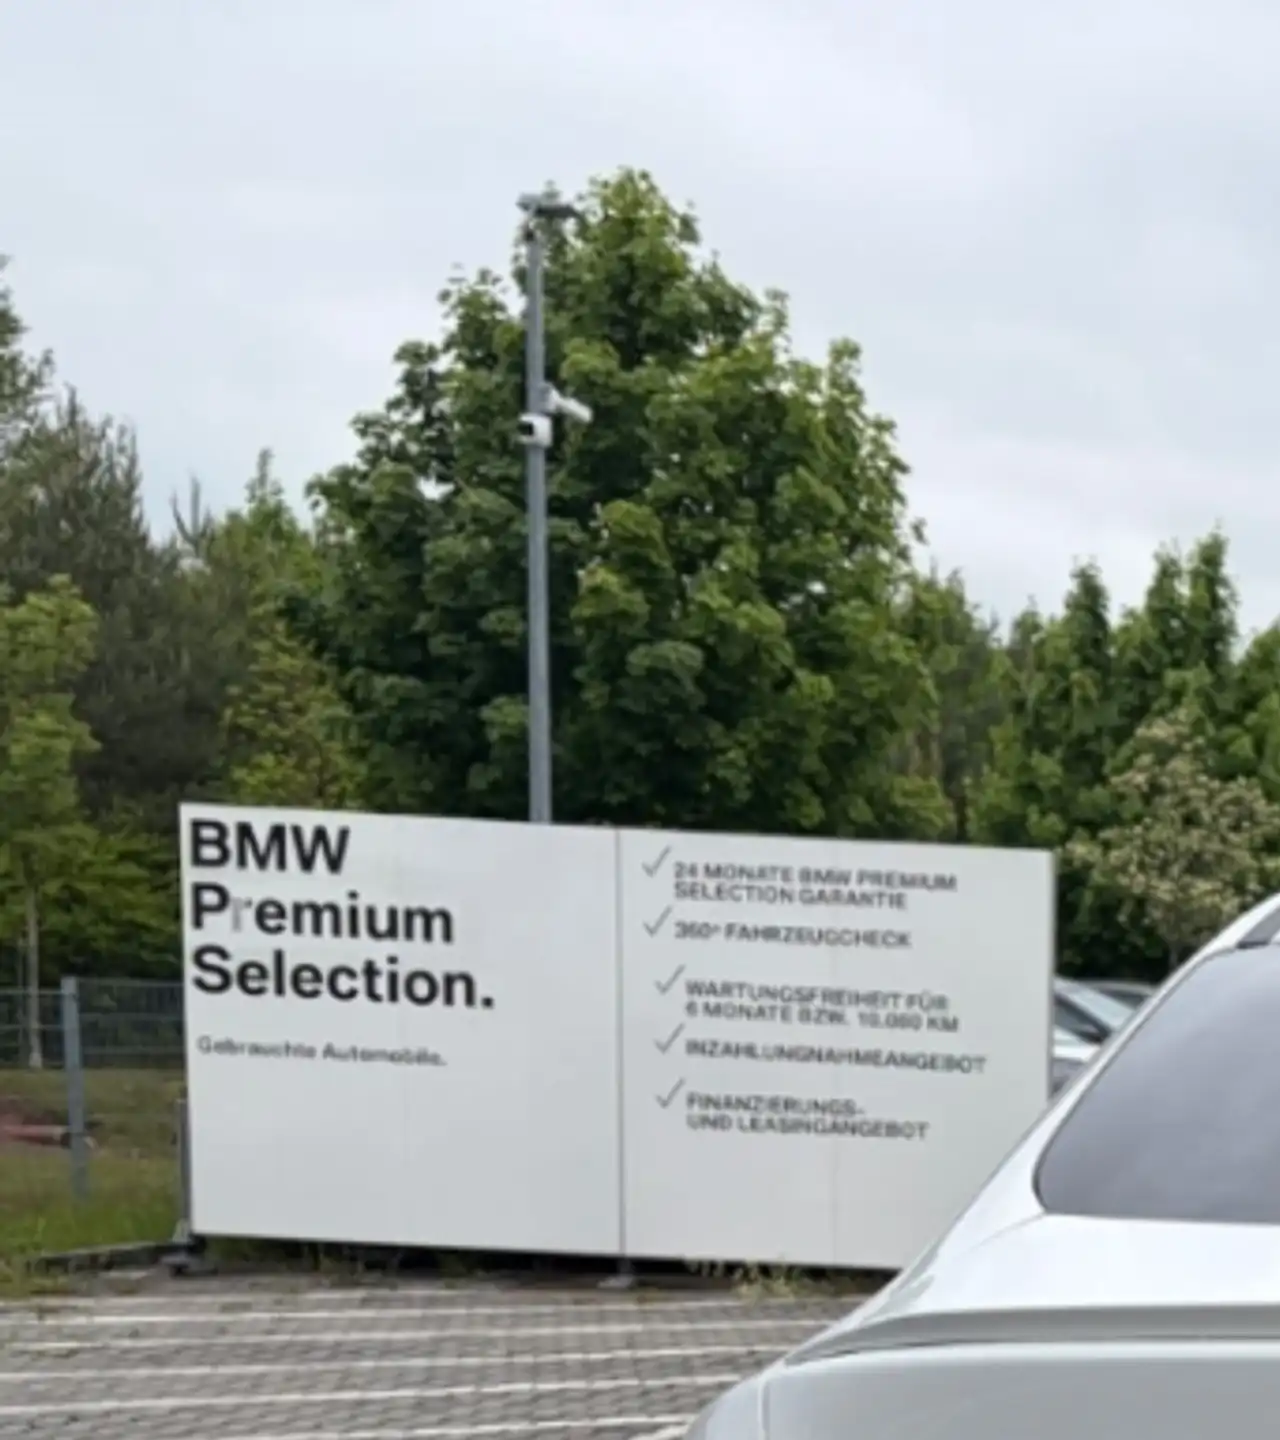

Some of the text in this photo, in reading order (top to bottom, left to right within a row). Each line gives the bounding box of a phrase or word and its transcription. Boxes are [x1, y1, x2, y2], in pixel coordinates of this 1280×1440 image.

[190, 818, 350, 874] BMW
[674, 861, 957, 892] 24 MONATE BMW PREMIUM
[674, 882, 908, 911] SELECTION GARANTIE
[190, 881, 454, 944] Premium
[725, 923, 913, 949] FAHRZEUGCHECK
[191, 944, 496, 1010] Selection.
[685, 980, 950, 1012] WARTUNGSFREIHEIT FÜR
[703, 1002, 794, 1024] MONATE
[798, 1007, 850, 1027] BZW.
[927, 1015, 960, 1034] KM
[197, 1035, 317, 1060] Gebrauchte
[687, 1112, 930, 1140] UND LEASINGANGEBOT
